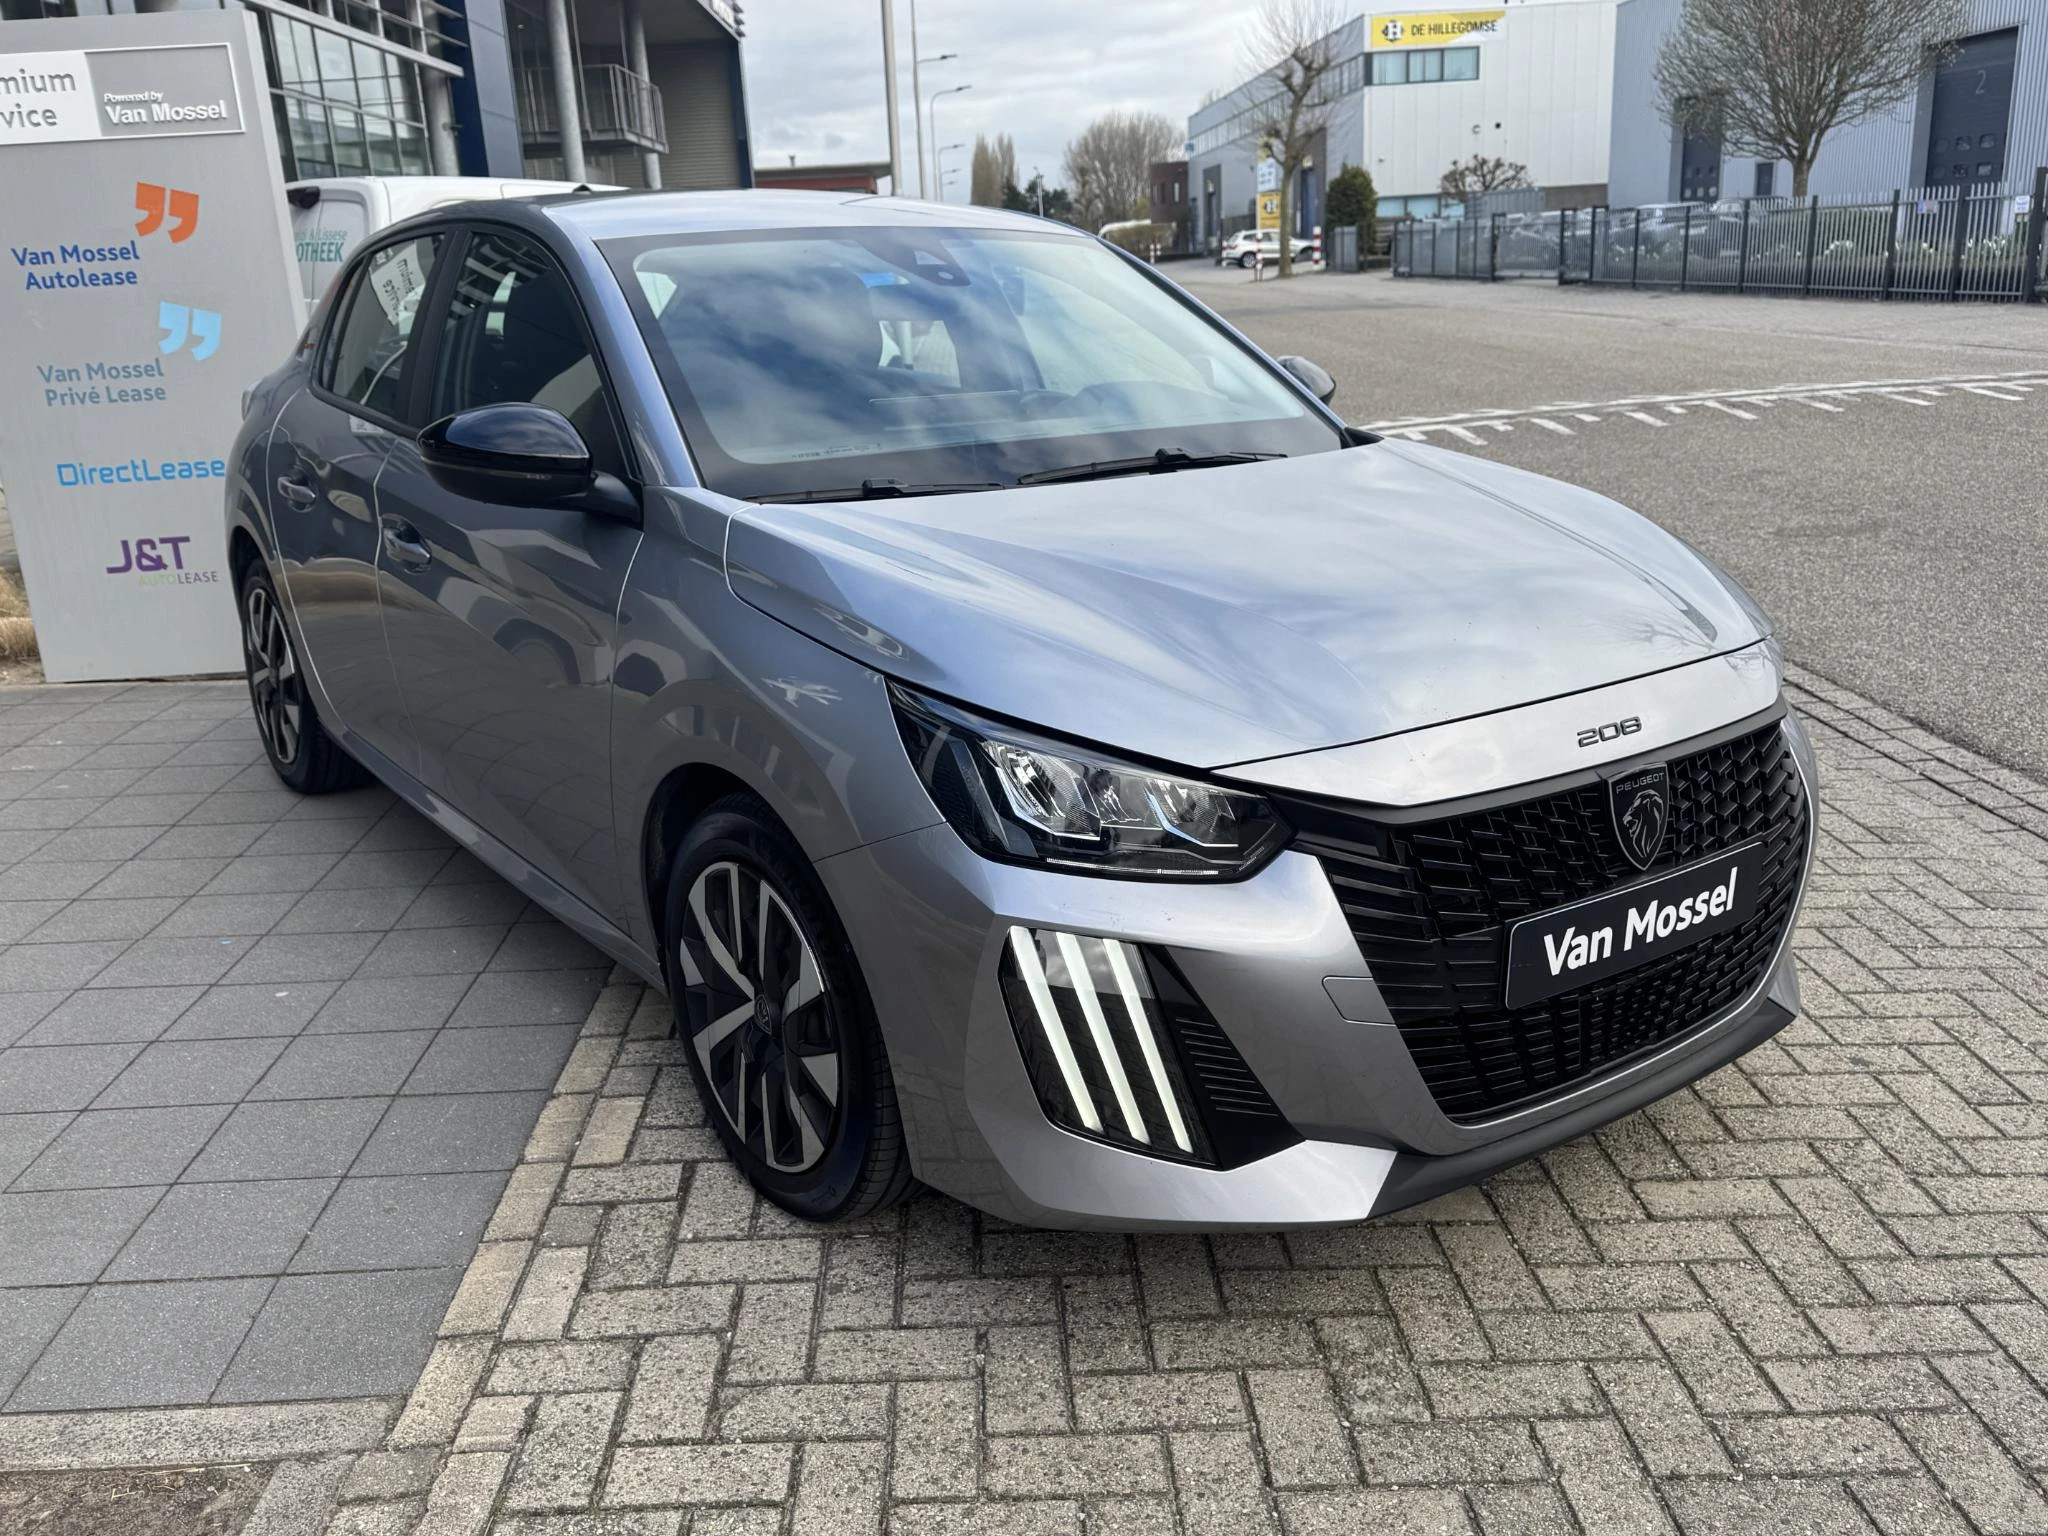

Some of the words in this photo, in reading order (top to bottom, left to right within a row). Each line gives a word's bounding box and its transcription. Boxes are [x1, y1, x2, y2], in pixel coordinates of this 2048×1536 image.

[1411, 24, 1426, 36] DE
[1428, 20, 1498, 35] HILLEGOMSE
[1976, 70, 1986, 94] 2
[104, 91, 148, 103] Powered
[150, 90, 164, 103] by
[105, 105, 147, 125] Van
[152, 99, 228, 122] Mossel
[11, 247, 55, 266] Van
[60, 240, 140, 263] Mossel
[25, 268, 138, 290] Autolease
[37, 365, 81, 383] Van
[85, 357, 165, 381] Mossel
[44, 386, 100, 407] Privé
[105, 385, 167, 404] Lease
[56, 459, 225, 487] DirectLease
[106, 536, 190, 574] J&T
[1577, 716, 1643, 748] 208
[1616, 773, 1664, 795] PEUGEOT
[1544, 927, 1613, 976] Van
[1624, 866, 1738, 951] Mossel
